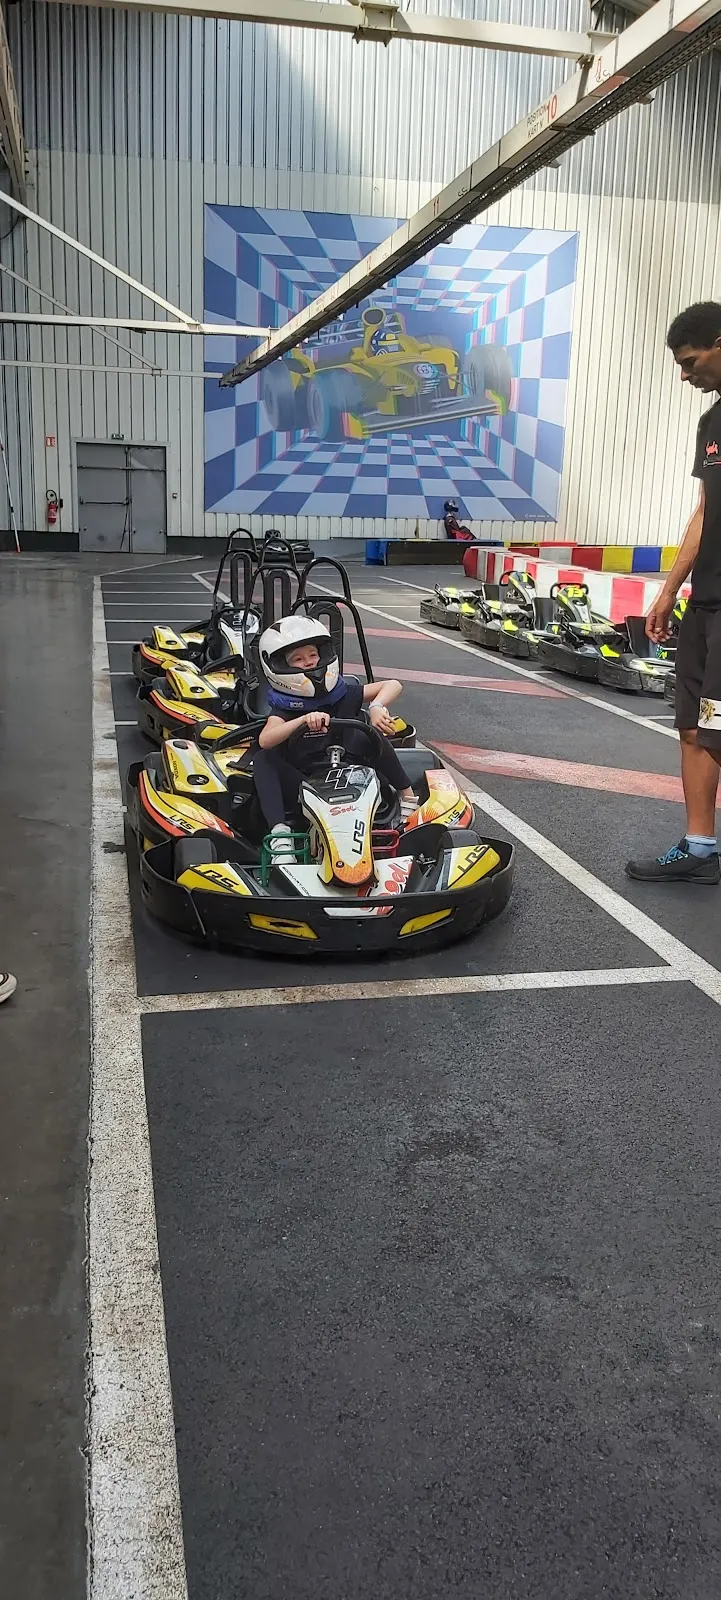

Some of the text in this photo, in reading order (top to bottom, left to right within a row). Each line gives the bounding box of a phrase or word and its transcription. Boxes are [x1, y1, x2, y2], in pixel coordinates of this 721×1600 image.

[526, 103, 547, 127] POSITION
[545, 94, 558, 123] 10
[527, 121, 540, 139] KART
[325, 768, 354, 790] 4
[169, 814, 196, 830] LRS
[444, 809, 461, 825] LRS
[351, 818, 366, 856] LRS
[457, 845, 488, 874] LRS
